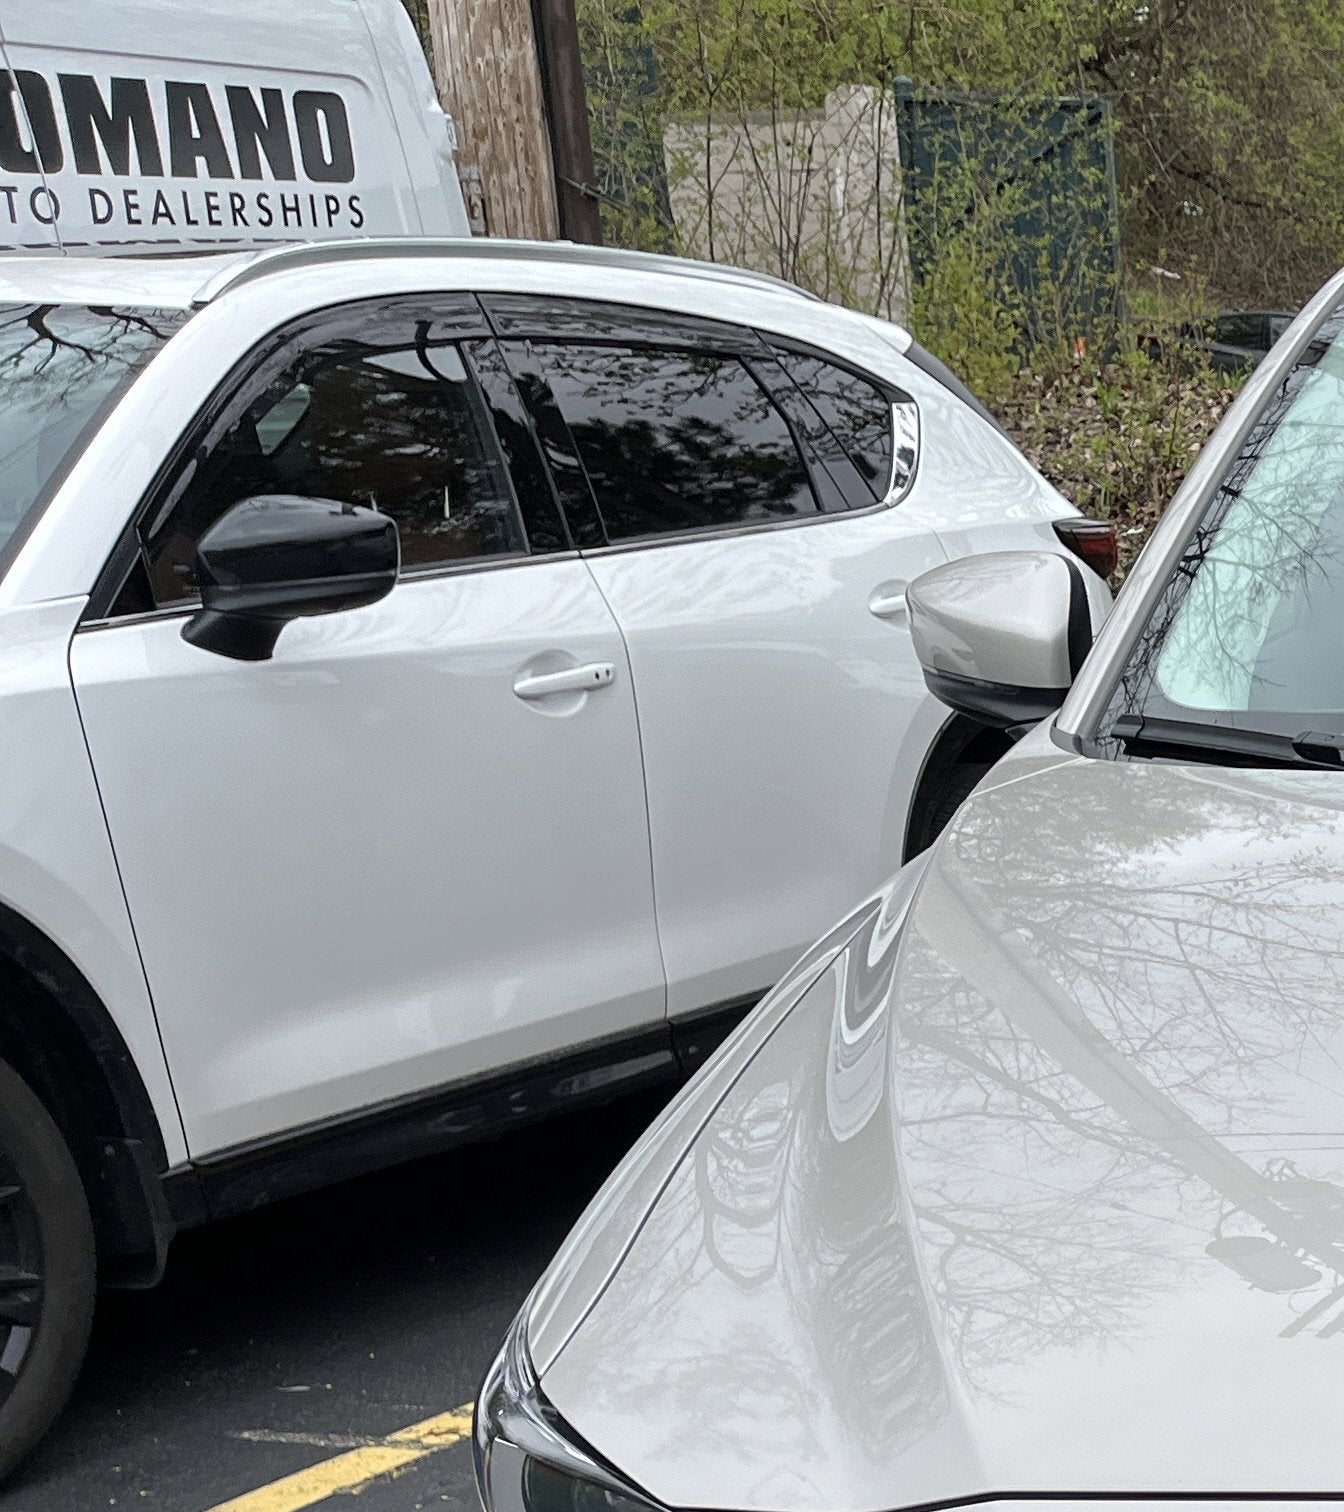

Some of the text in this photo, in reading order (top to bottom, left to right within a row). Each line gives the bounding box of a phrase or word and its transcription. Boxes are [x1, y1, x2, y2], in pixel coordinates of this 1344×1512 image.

[0, 69, 355, 183] OMANO
[0, 186, 364, 228] TO DEALERSHIPS
